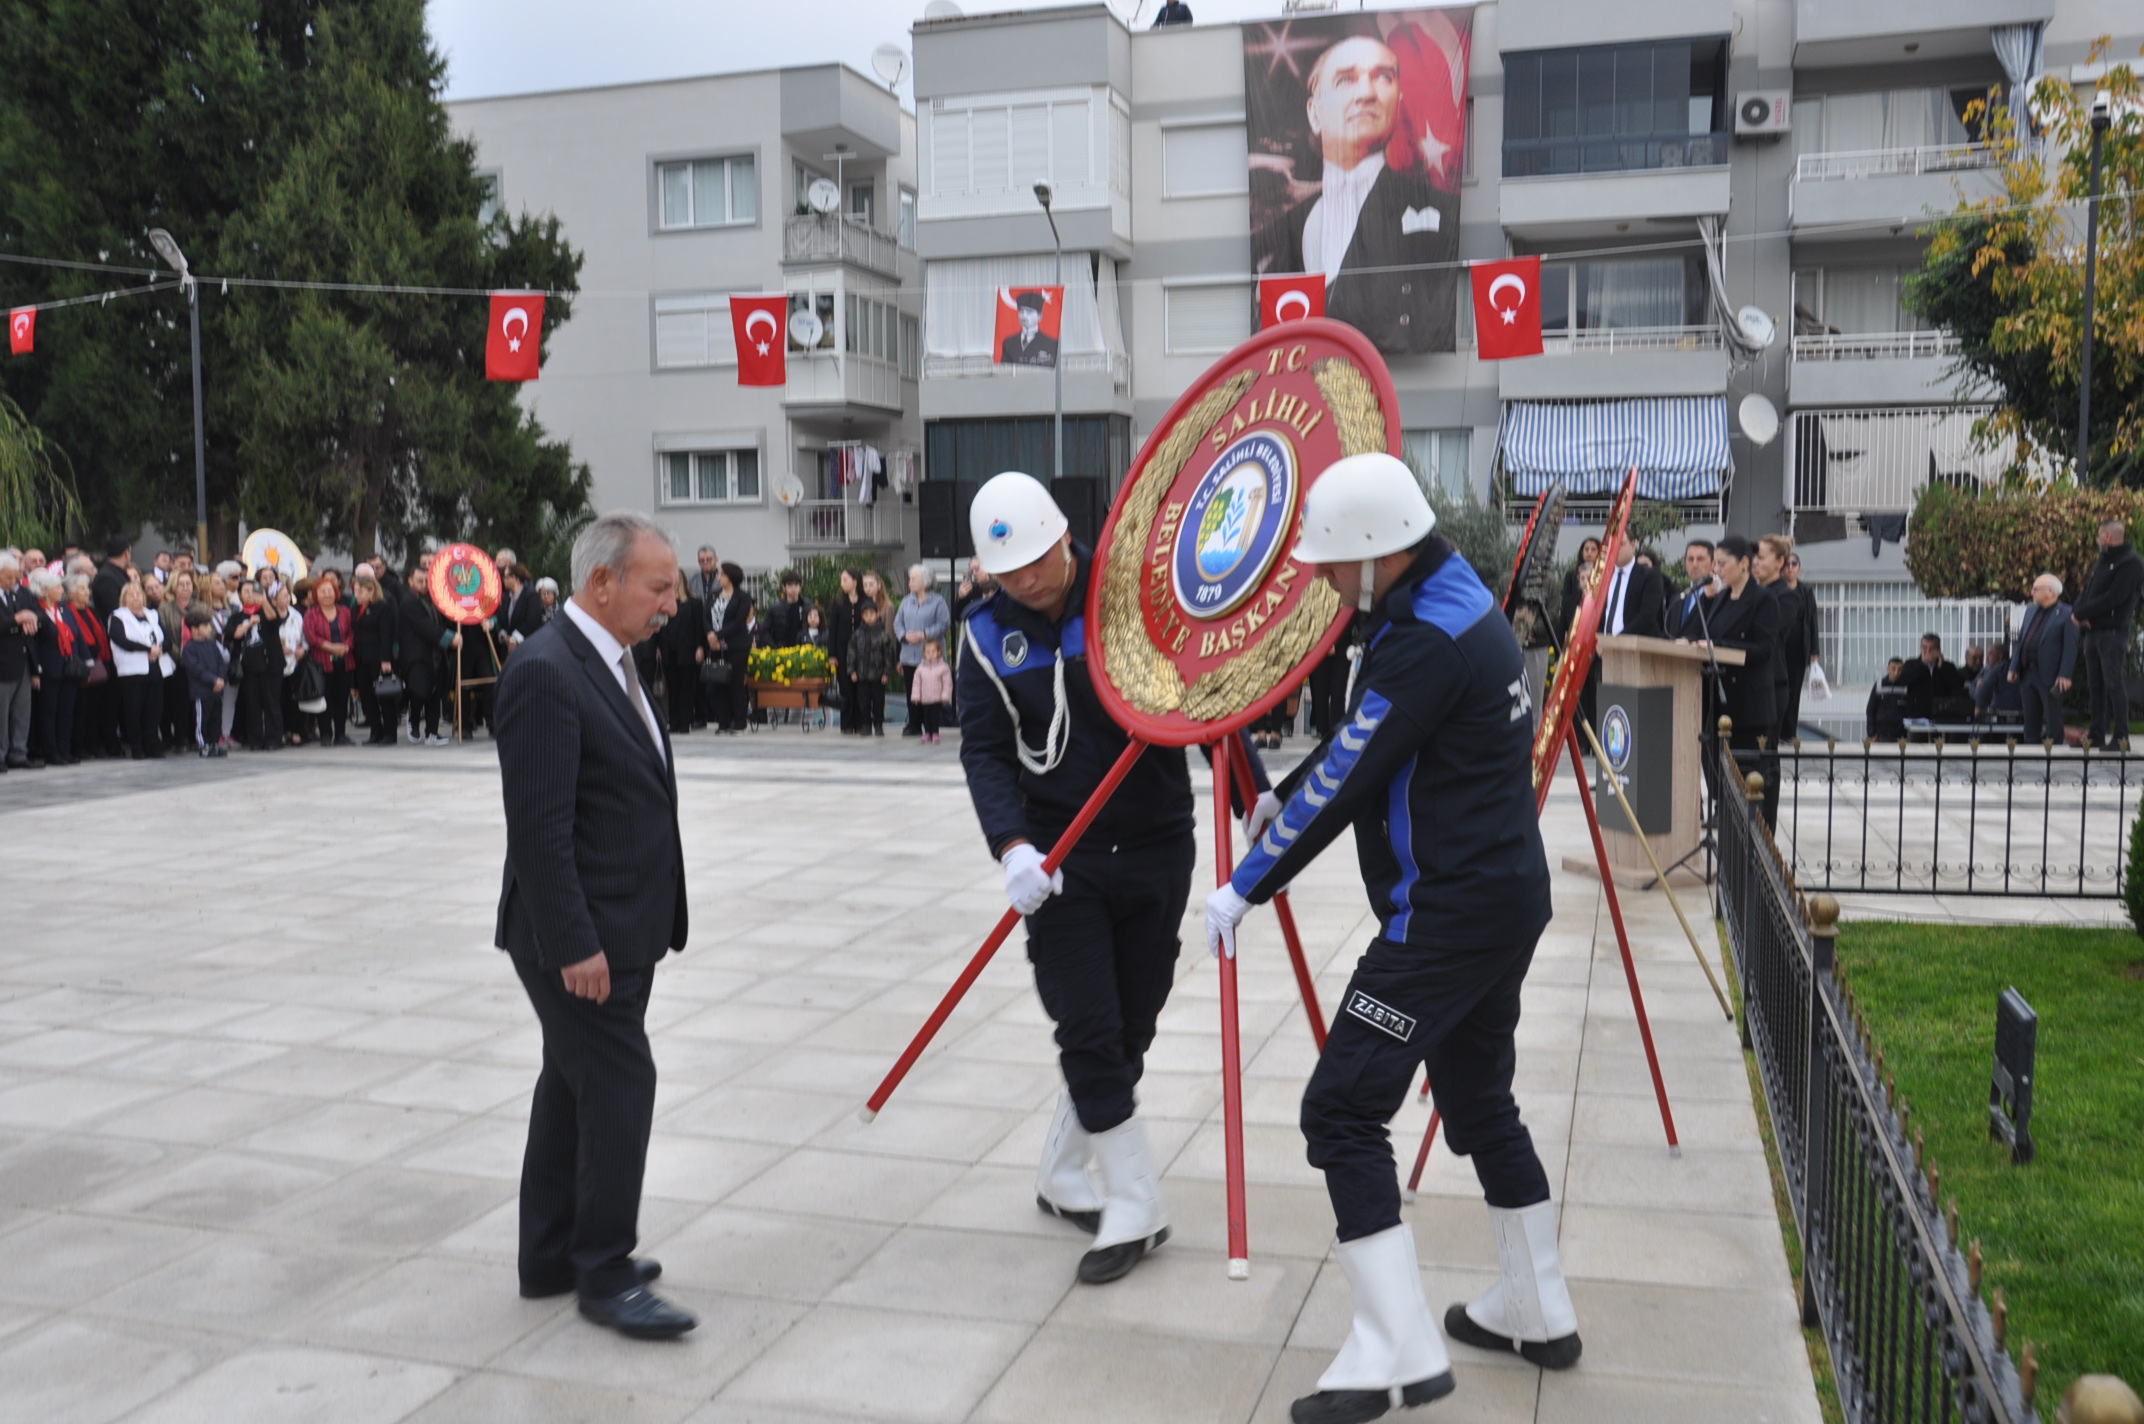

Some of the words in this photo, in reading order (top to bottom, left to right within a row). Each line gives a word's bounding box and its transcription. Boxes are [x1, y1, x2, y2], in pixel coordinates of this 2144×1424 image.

[1266, 344, 1307, 375] T.C.
[1212, 387, 1324, 452] SALİHLİ
[1212, 440, 1256, 487] SALİHLİ
[1151, 501, 1191, 655] BELEDİYE
[1195, 583, 1222, 604] 1879
[1507, 666, 1532, 723] ZA
[1355, 998, 1405, 1034] ZABITA
